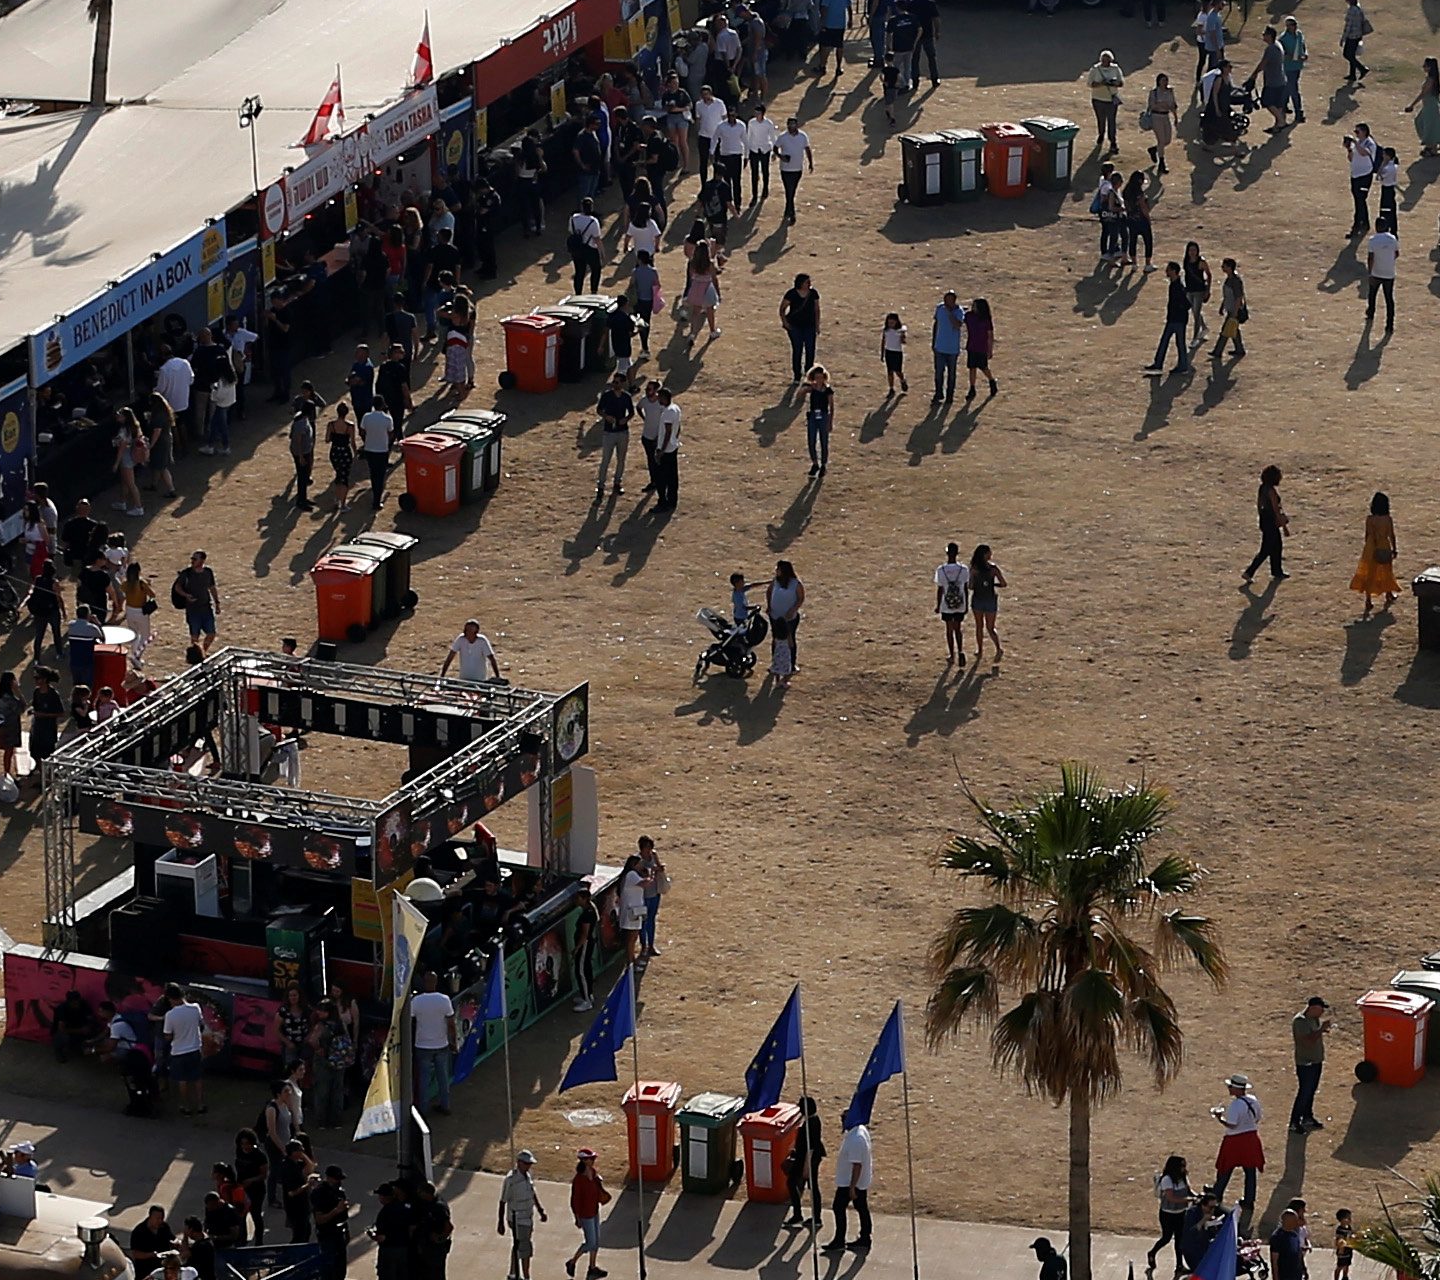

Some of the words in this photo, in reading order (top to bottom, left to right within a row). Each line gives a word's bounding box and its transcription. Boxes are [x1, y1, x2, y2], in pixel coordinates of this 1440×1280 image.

[385, 121, 404, 145] TASH
[409, 103, 432, 131] TASHA
[73, 289, 137, 348] BENEDICT
[140, 285, 154, 306] IN
[155, 274, 166, 297] A
[166, 254, 193, 289] BOX
